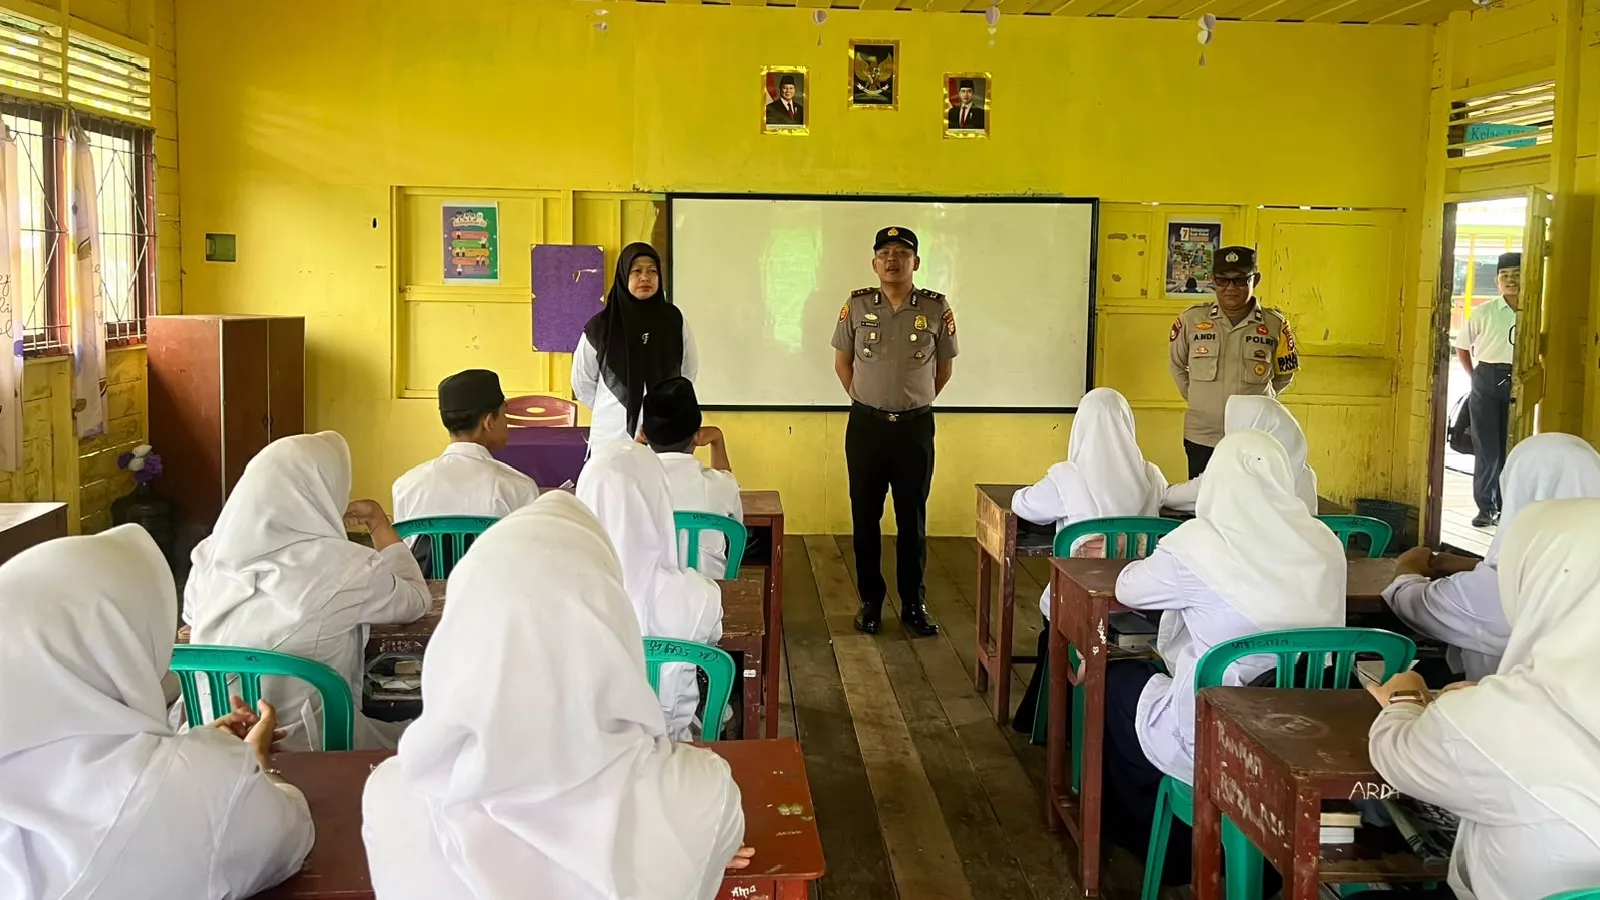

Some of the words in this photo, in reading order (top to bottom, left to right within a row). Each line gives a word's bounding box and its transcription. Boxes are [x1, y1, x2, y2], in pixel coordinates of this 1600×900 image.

[1193, 333, 1216, 341] ANDI
[1245, 335, 1273, 346] POLRI
[1348, 781, 1400, 800] ARDA
